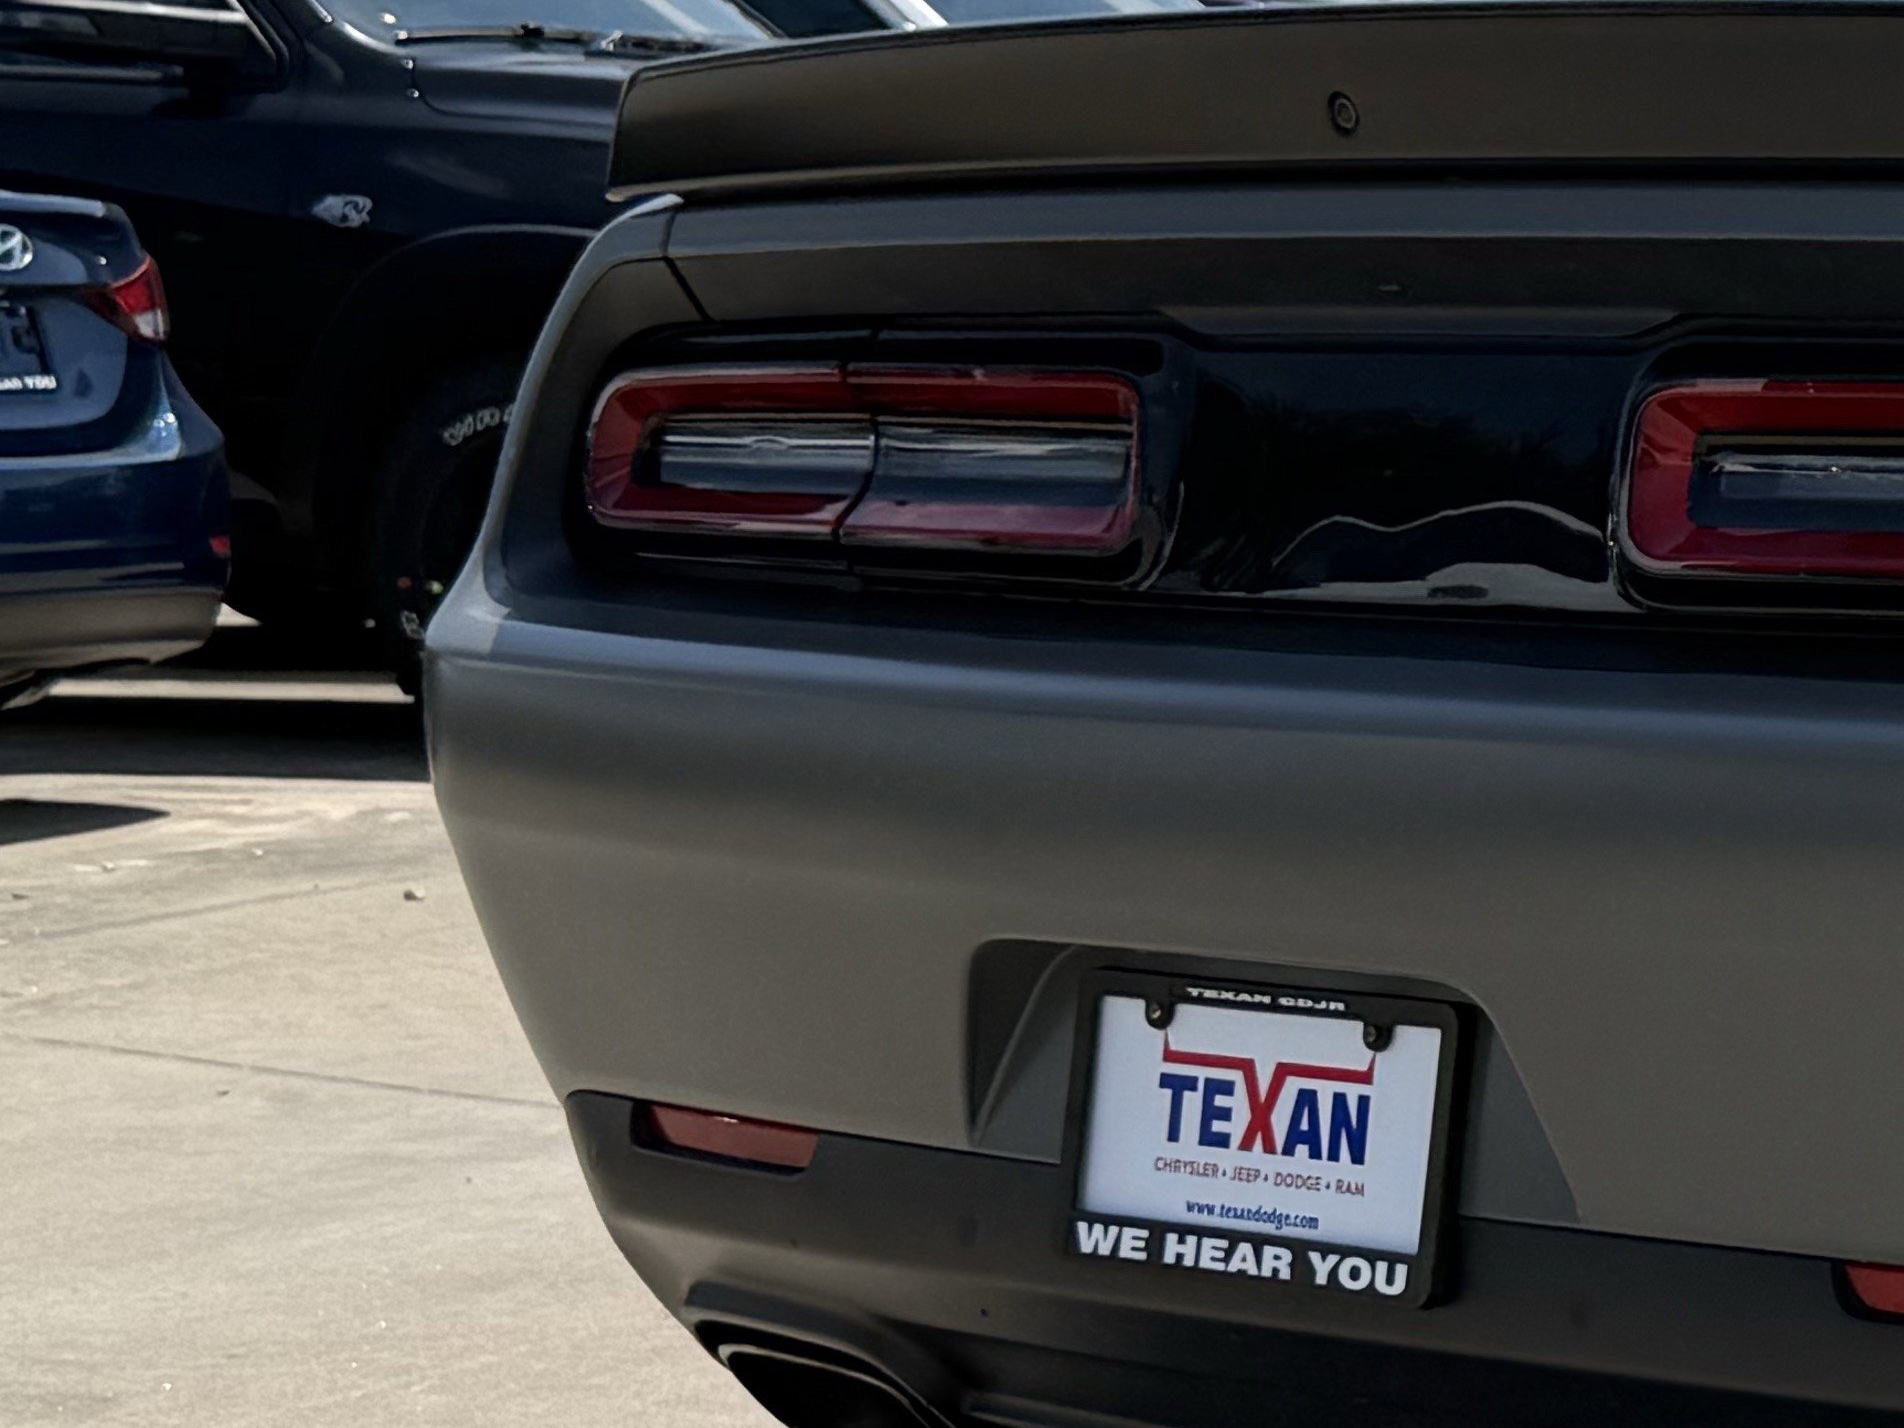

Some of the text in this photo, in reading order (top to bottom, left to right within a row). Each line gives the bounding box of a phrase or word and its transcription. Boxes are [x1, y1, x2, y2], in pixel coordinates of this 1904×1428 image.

[1185, 986, 1272, 1005] TEXAN
[1158, 1054, 1374, 1167] TEXAN
[1153, 1156, 1365, 1198] CHRYSLER JEEP DODGE RAM
[1076, 1220, 1409, 1297] WE HEAR YOU
